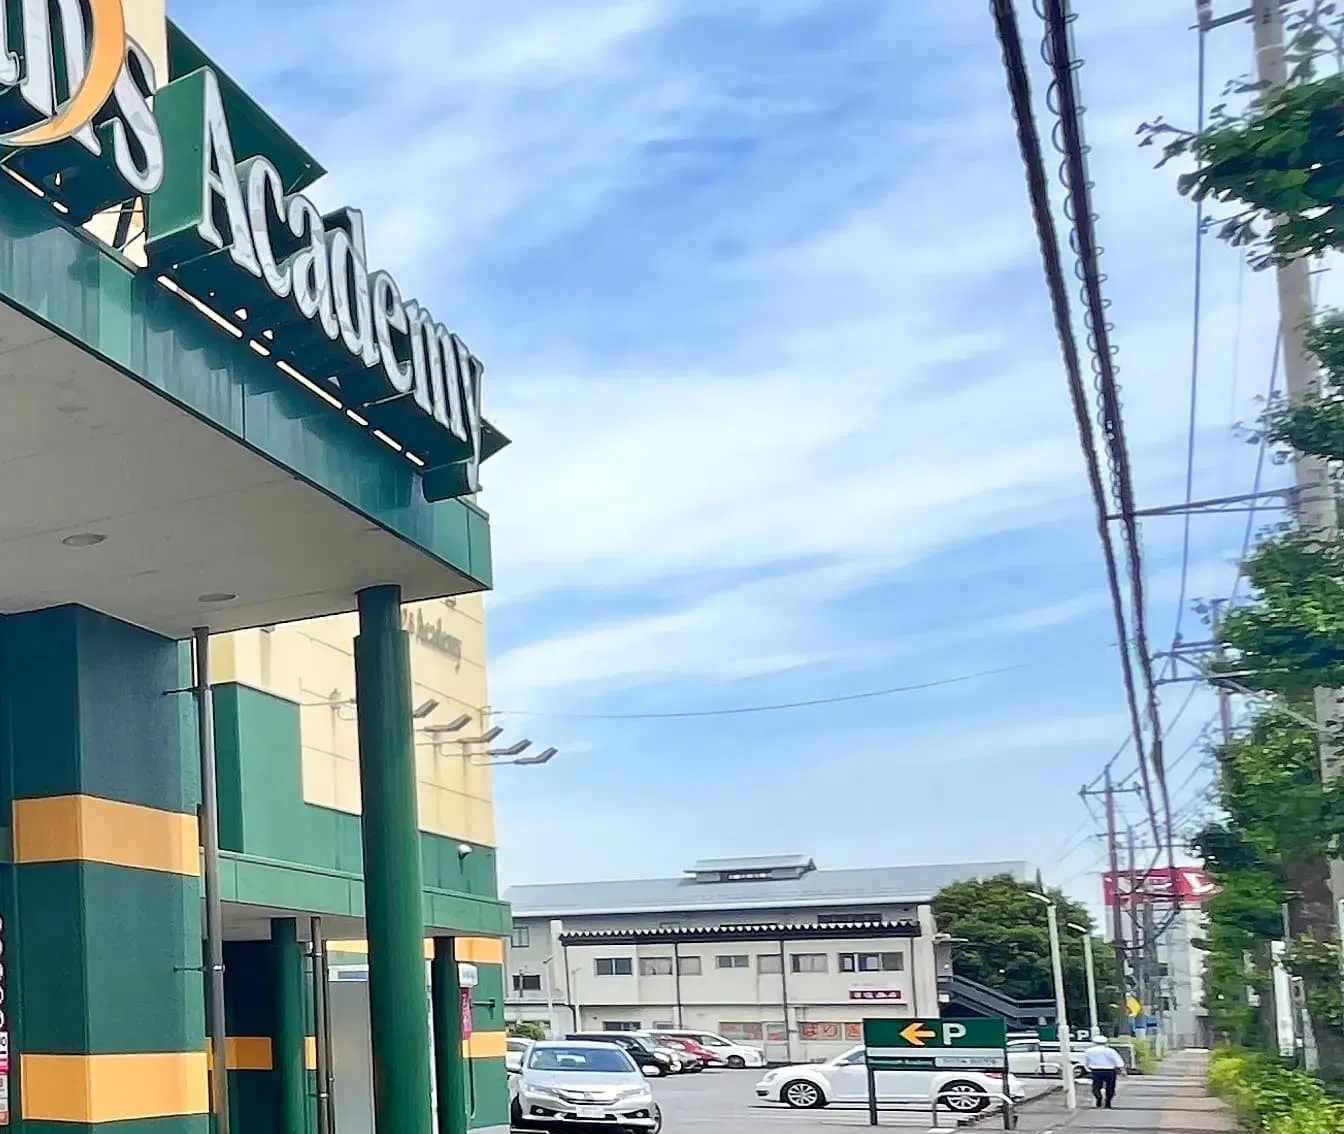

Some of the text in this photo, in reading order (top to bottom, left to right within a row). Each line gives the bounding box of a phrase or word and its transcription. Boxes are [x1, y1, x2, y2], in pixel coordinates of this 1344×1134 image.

[197, 66, 484, 492] Academy
[942, 1023, 967, 1045] P
[1077, 1030, 1090, 1041] P
